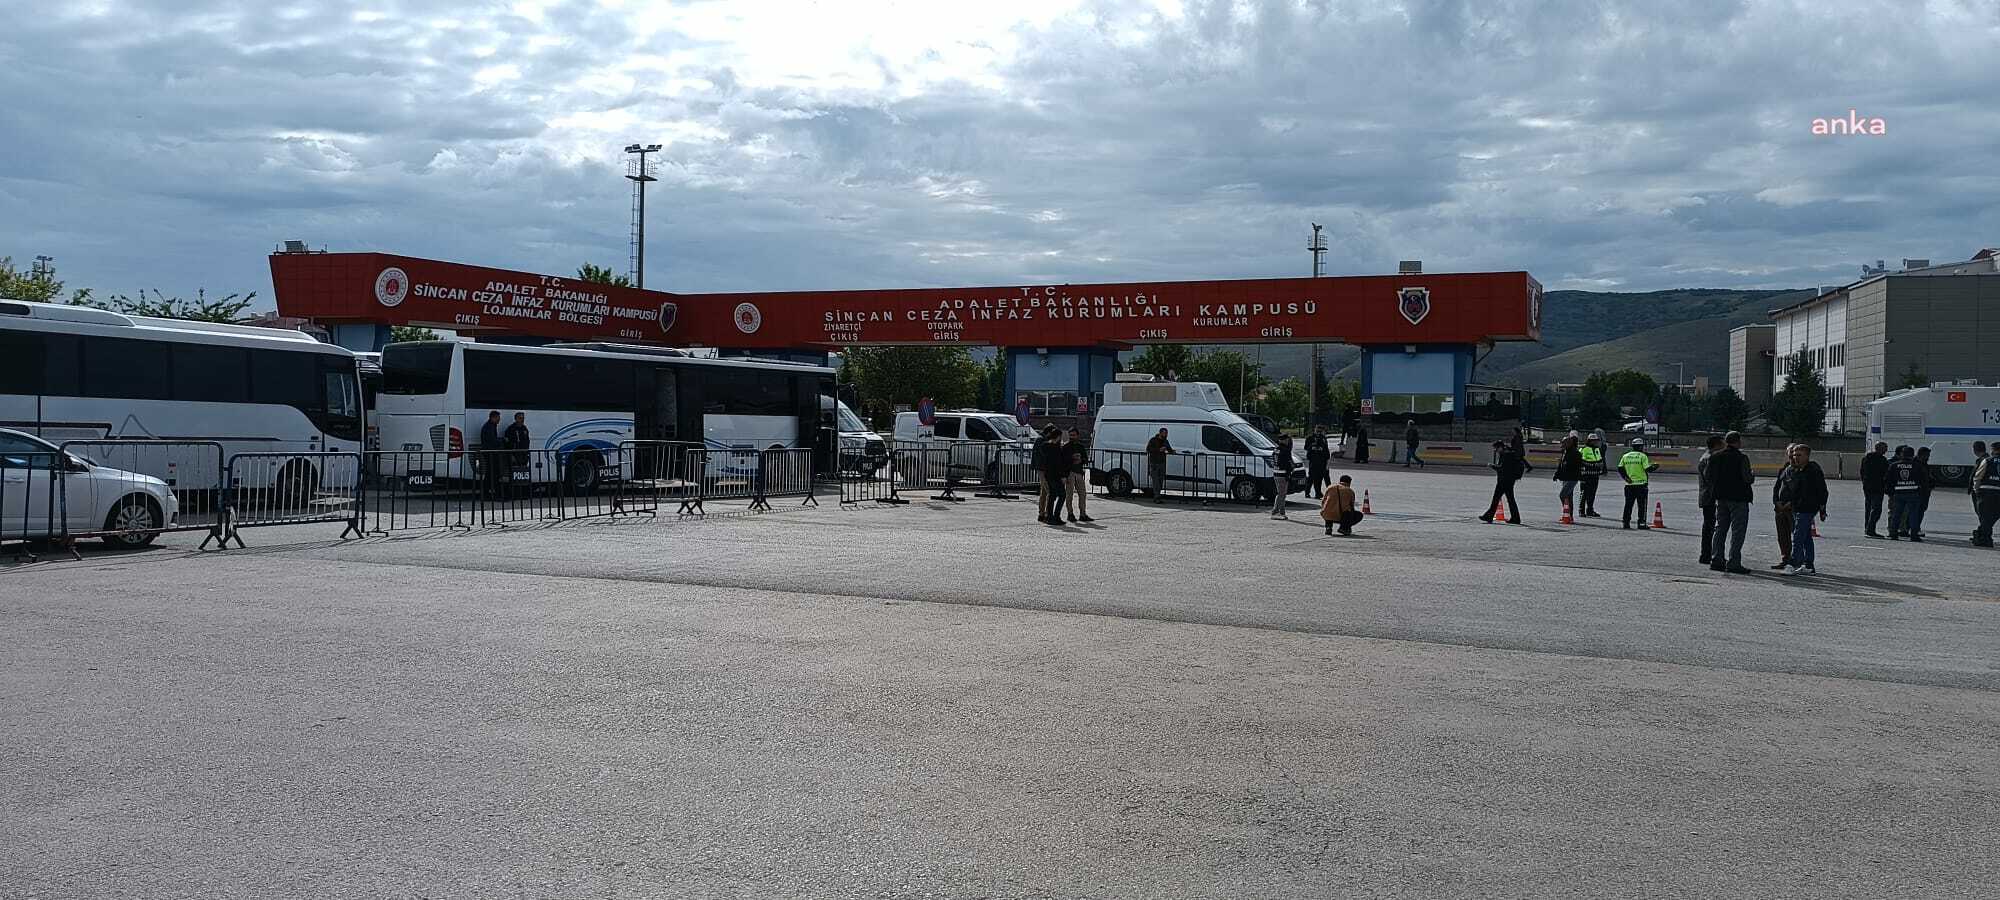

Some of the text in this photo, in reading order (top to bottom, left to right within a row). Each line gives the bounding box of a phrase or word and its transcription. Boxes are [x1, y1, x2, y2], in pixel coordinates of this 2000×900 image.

[540, 276, 565, 288] T.C.
[485, 281, 608, 304] ADALET BAKANLIĞI
[414, 283, 658, 321] SİNCAN CEZA İNFAZ KURUMLARI KAMPUSÜ
[939, 292, 1157, 309] ADALET BAKANLIĞI
[483, 304, 603, 325] LOJMANLAR BÖLGESİ
[825, 300, 1316, 322] SİNCAN CEZA İNFAZ KURUMLARI KAMPUSÜ
[455, 313, 480, 325] ÇIKIŞ
[1193, 317, 1248, 326] KURUMLAR
[824, 321, 862, 332] ZİYARETÇİ
[927, 321, 964, 331] OTOPARK
[1261, 326, 1293, 338] GİRİŞ
[830, 332, 858, 342] ÇIKIŞ
[933, 331, 960, 341] GİRİŞ
[1140, 329, 1168, 339] ÇIKIŞ
